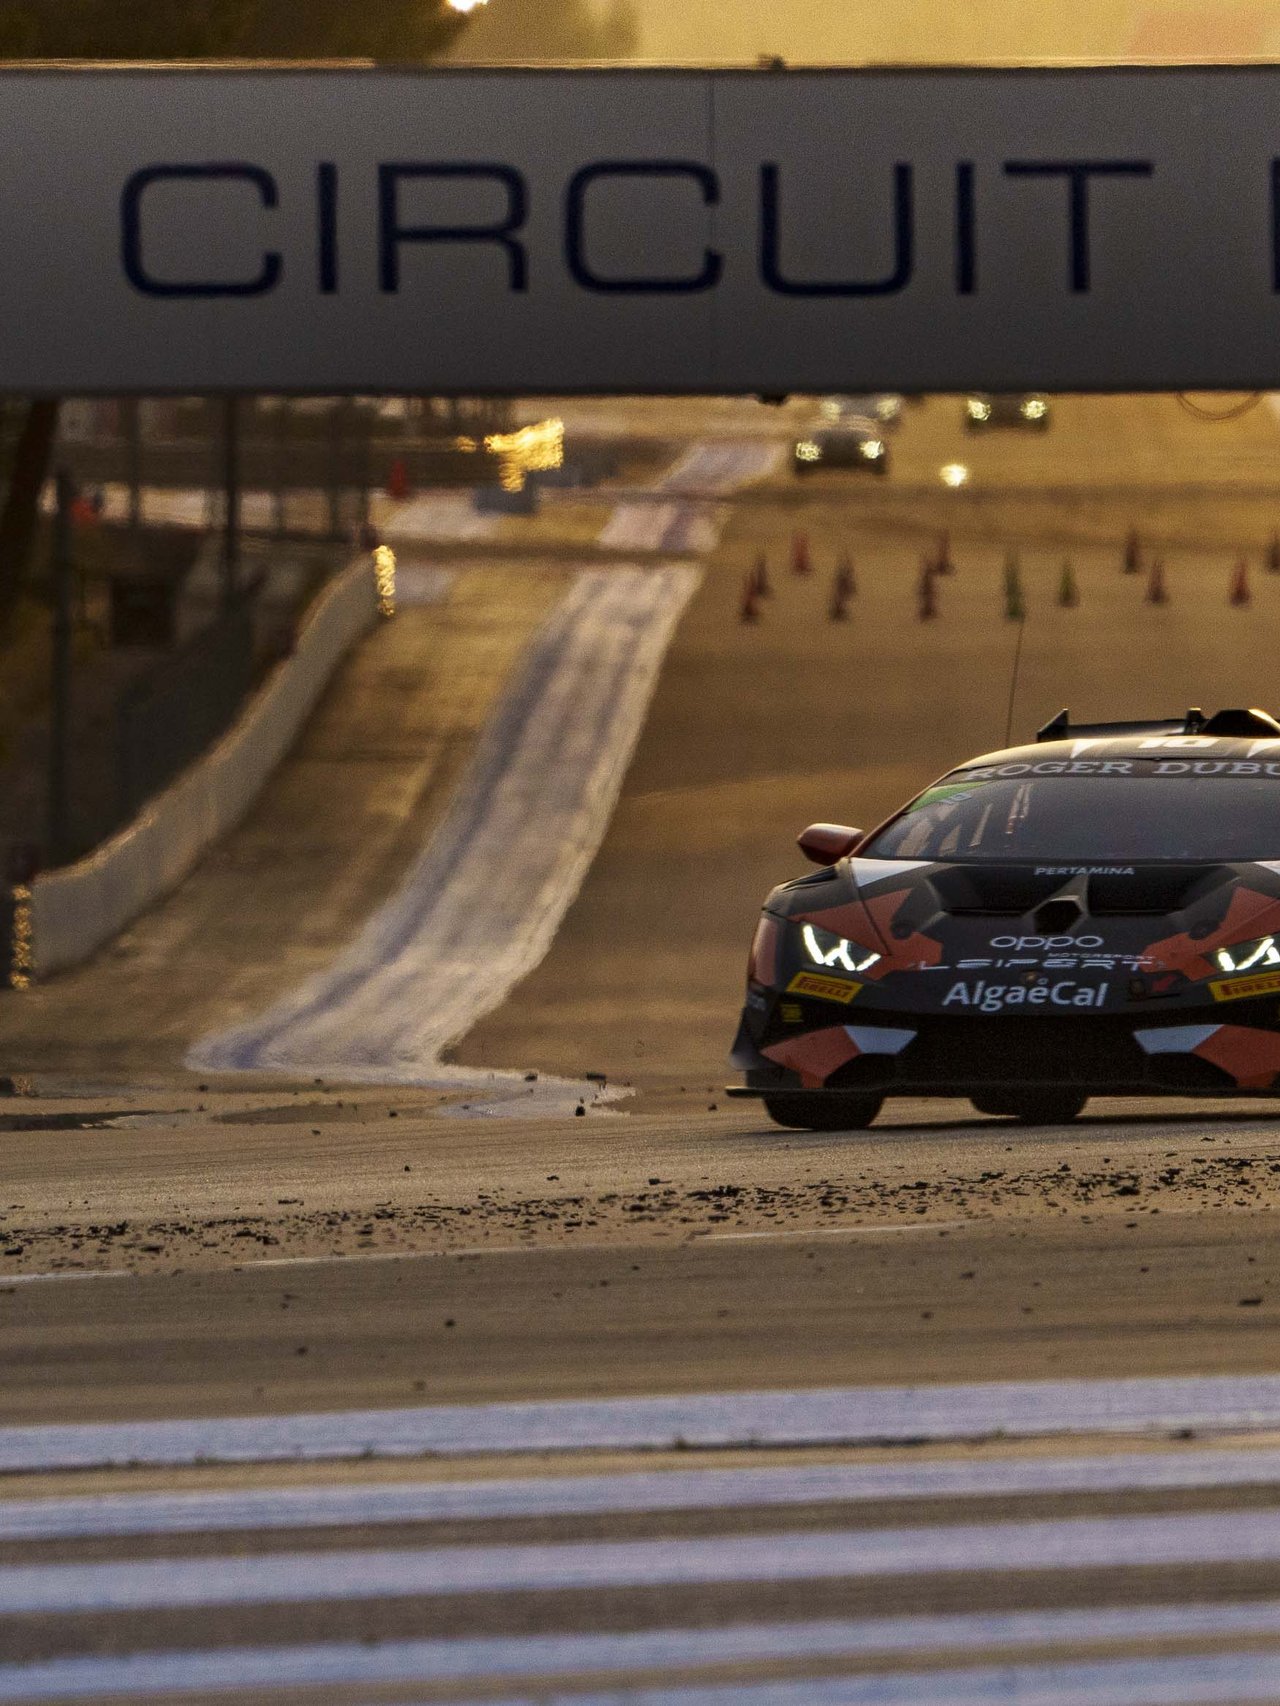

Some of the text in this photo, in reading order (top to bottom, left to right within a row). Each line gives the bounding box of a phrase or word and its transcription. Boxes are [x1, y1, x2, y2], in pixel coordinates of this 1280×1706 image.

[119, 159, 1155, 299] CIRCUIT
[963, 760, 1134, 782] ROGER
[1033, 866, 1136, 876] PERTAMINA
[989, 935, 1105, 951] oppo
